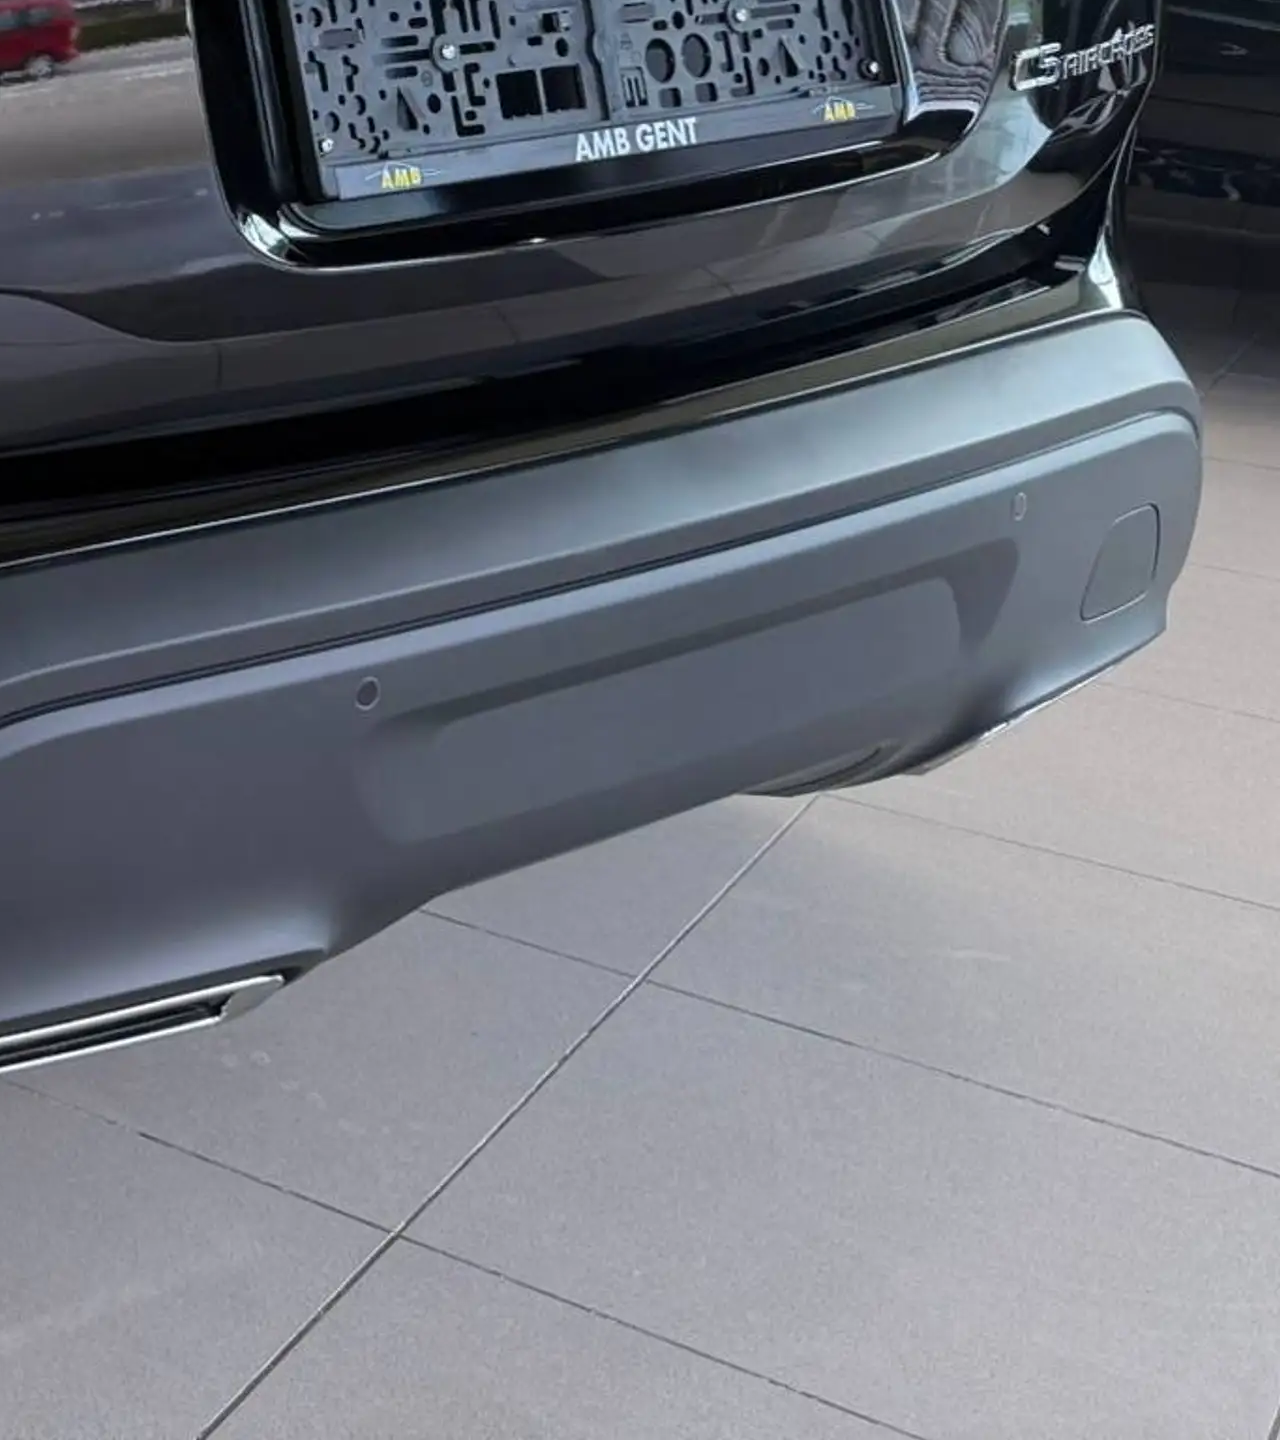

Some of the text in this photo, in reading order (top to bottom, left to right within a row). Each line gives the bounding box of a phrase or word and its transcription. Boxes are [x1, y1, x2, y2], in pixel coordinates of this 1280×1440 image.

[824, 101, 856, 122] AMB
[576, 116, 698, 161] AMB GENT
[382, 166, 422, 189] AMB
